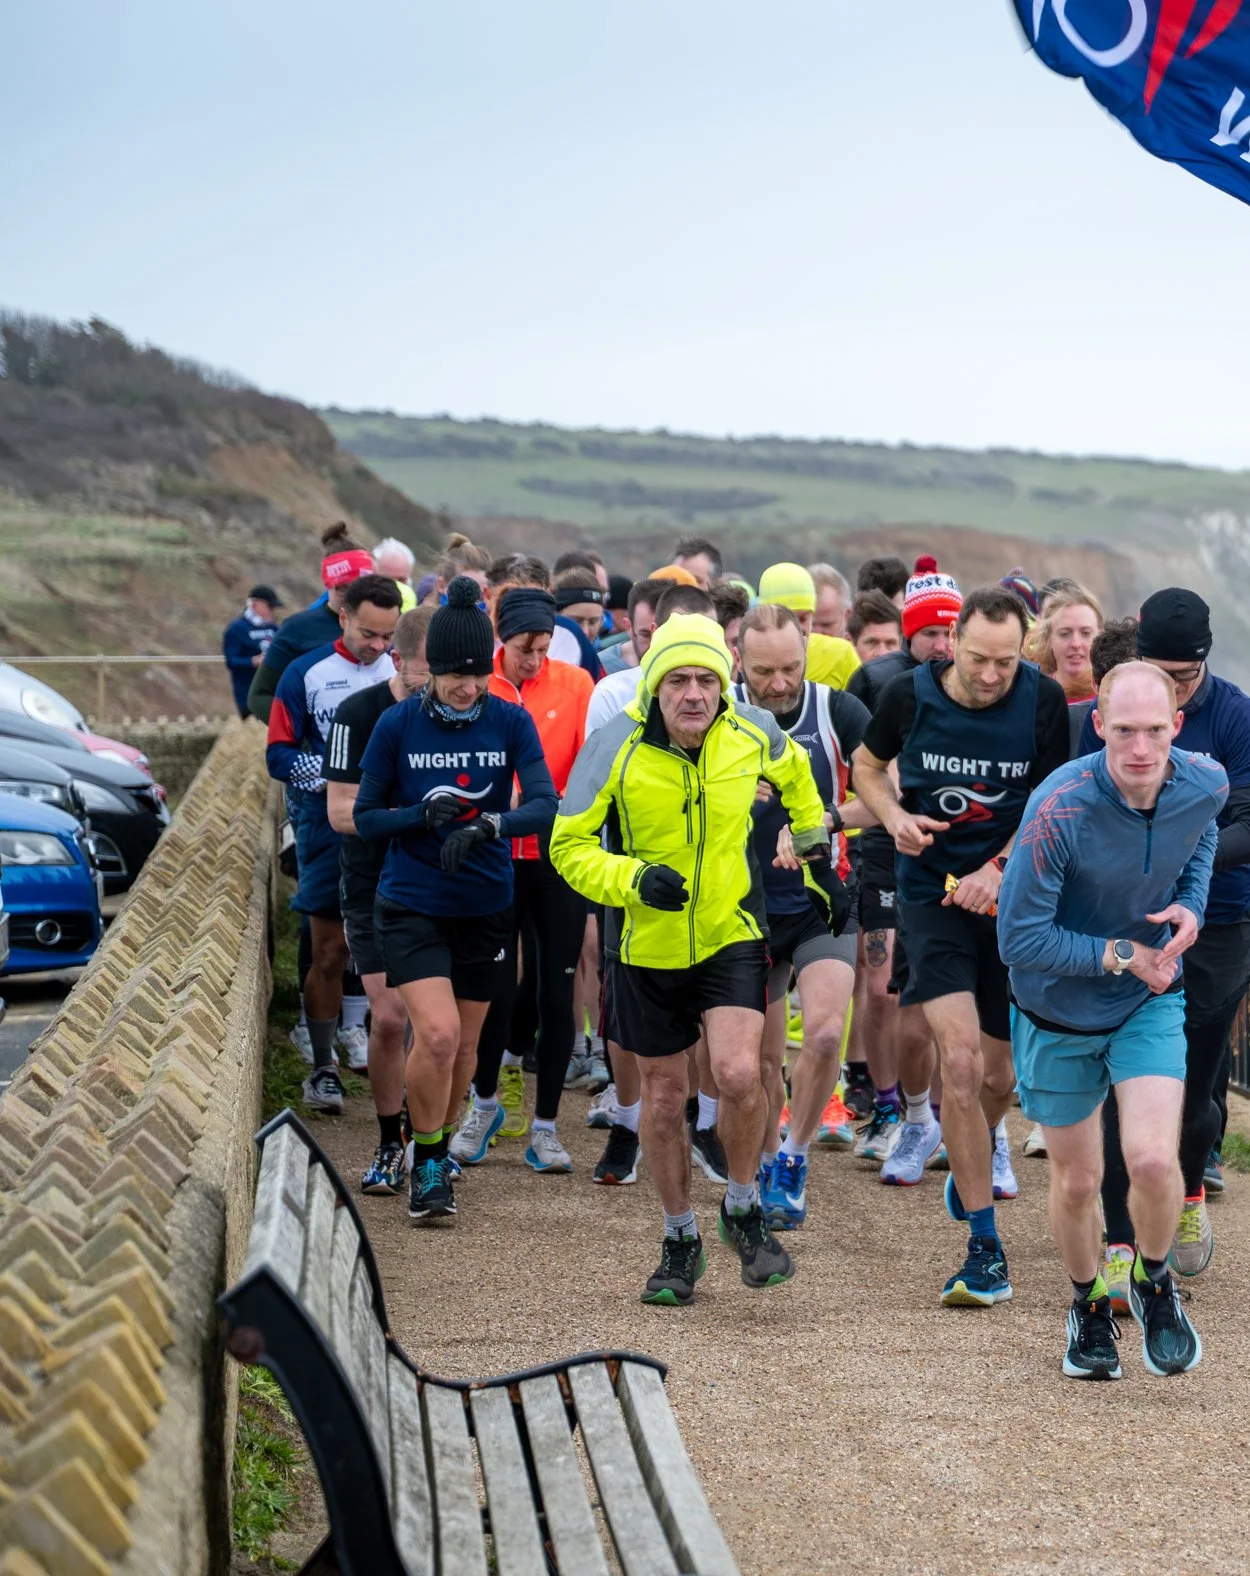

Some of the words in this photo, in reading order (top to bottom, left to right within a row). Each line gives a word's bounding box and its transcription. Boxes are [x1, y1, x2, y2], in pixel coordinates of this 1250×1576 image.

[908, 575, 941, 593] rest
[407, 752, 471, 769] WIGHT
[475, 751, 507, 767] TRI
[921, 751, 991, 776] WIGHT
[997, 760, 1031, 778] TRI
